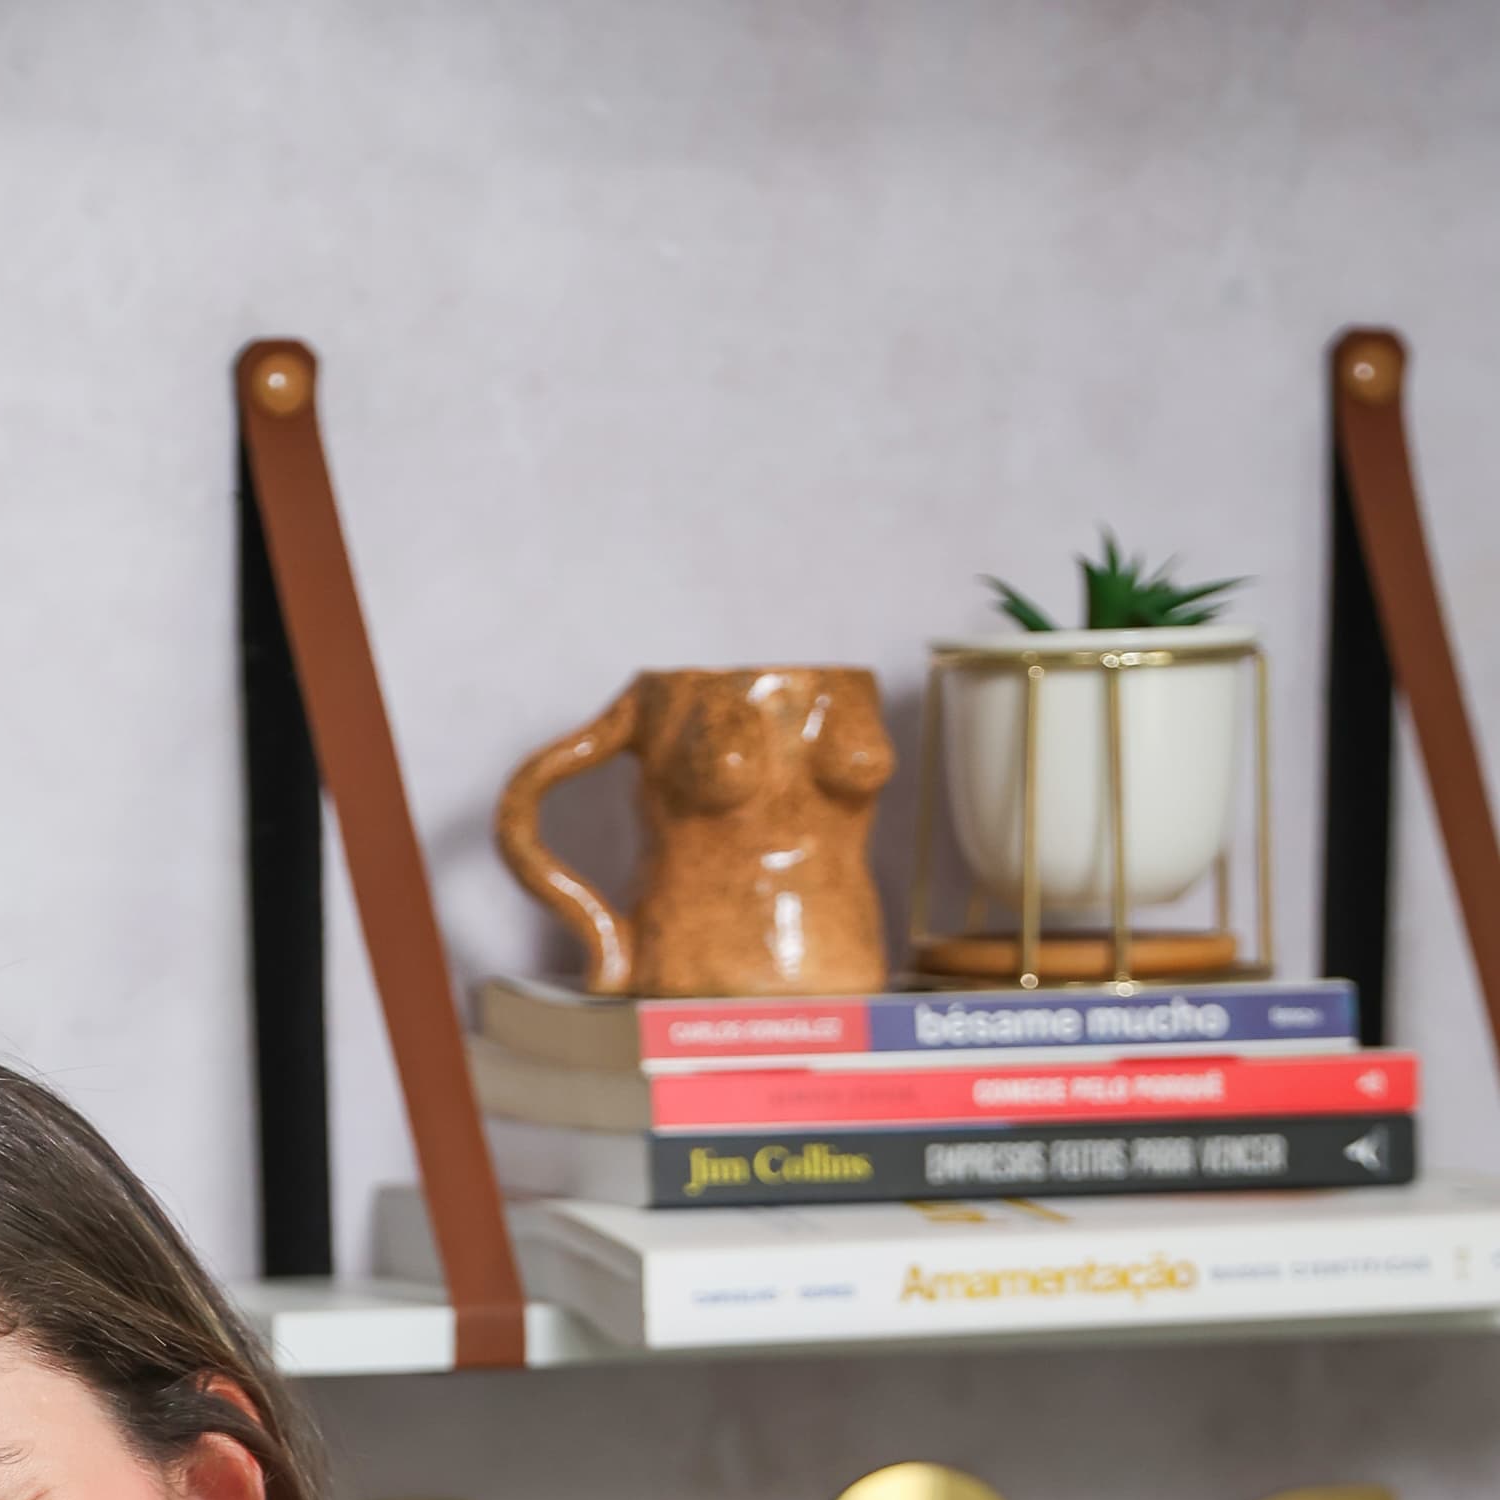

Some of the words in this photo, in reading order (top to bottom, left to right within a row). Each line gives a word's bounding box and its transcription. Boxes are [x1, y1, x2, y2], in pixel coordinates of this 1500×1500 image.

[915, 1002, 1084, 1045] bésame
[1086, 997, 1230, 1040] mucho
[683, 1147, 750, 1196] Jim
[753, 1143, 875, 1185] Collins
[900, 1250, 1197, 1306] Amamentação
